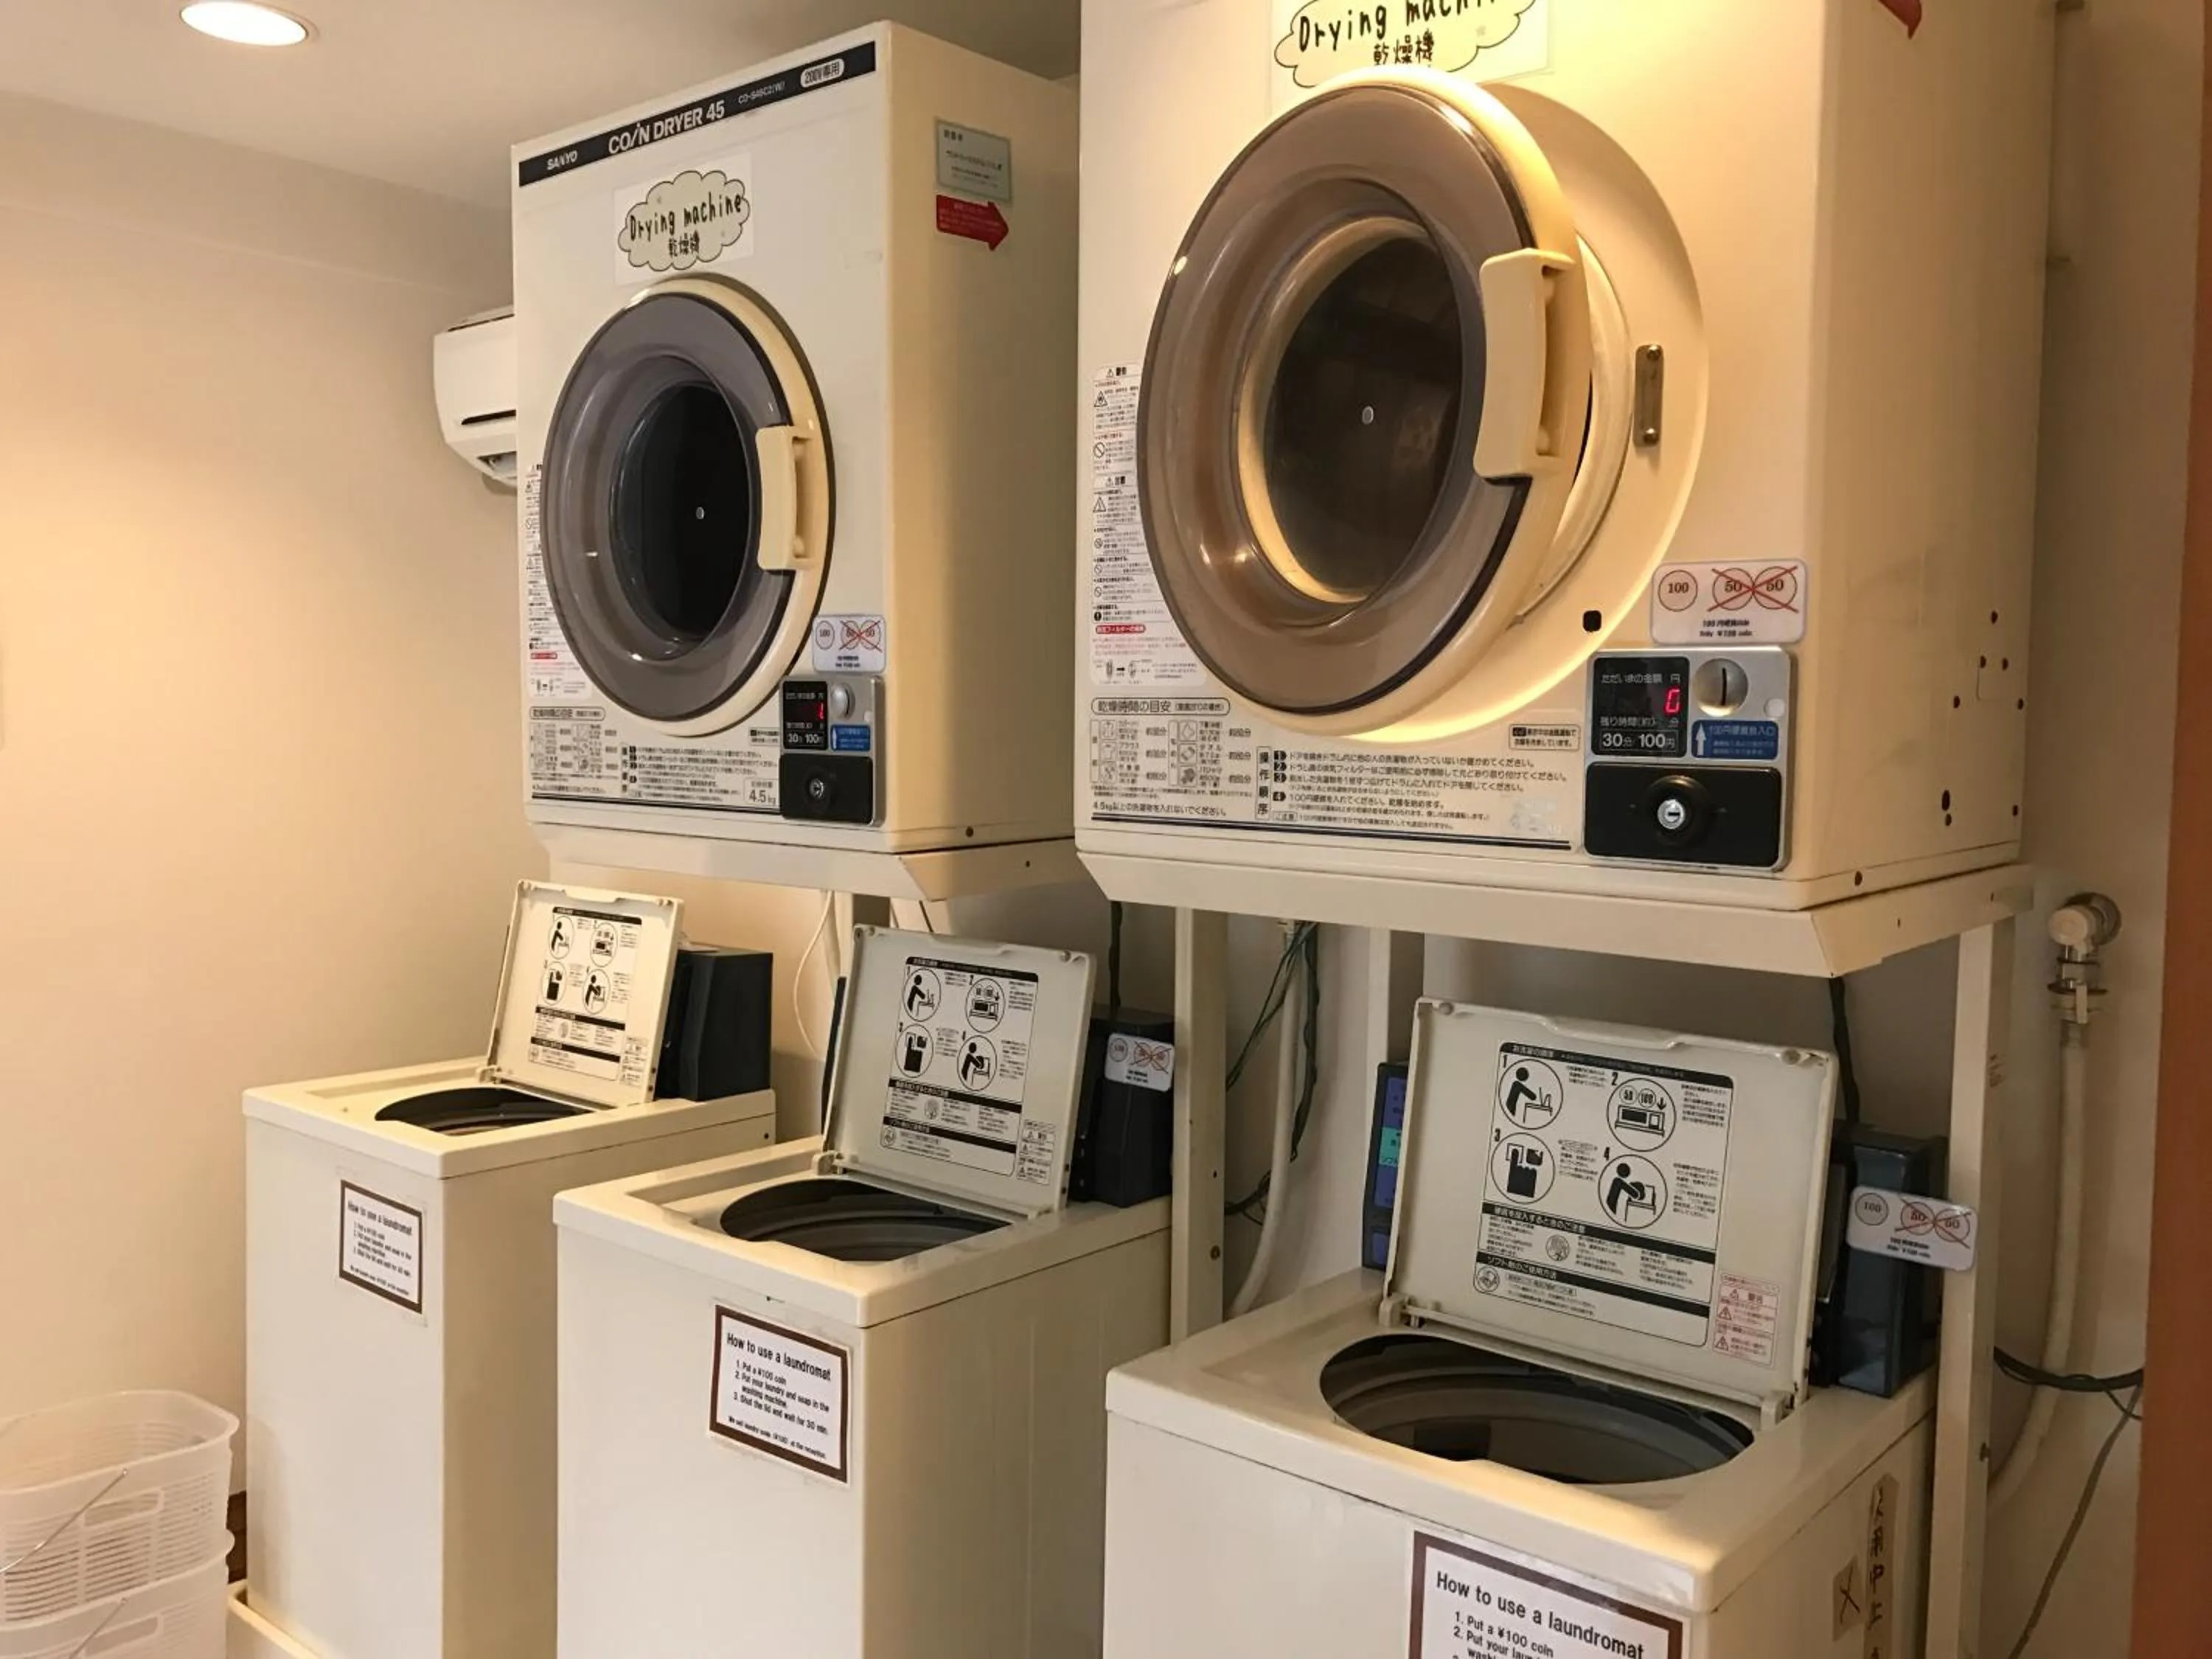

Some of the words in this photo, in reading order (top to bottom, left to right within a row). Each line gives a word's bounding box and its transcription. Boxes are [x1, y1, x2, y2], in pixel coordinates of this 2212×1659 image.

[1298, 4, 1387, 52] Drying
[1373, 28, 1434, 66] 乾燥機
[608, 122, 650, 155] COIN
[653, 106, 703, 141] DRYER
[706, 100, 726, 121] 45
[546, 148, 578, 170] SANYO
[630, 210, 675, 243] Drying
[684, 191, 742, 228] machine
[1668, 582, 1689, 594] 100
[1611, 1071, 1618, 1086] 2
[1495, 1128, 1500, 1142] 3
[726, 1332, 745, 1350] How
[746, 1339, 756, 1354] to
[757, 1346, 773, 1360] use
[775, 1352, 781, 1363] a
[783, 1352, 831, 1381] laundromat
[1436, 1571, 1470, 1599] How
[1475, 1585, 1492, 1606] to
[1497, 1596, 1526, 1619] use
[1532, 1609, 1543, 1626] a
[1548, 1610, 1644, 1659] laundromat
[1455, 1610, 1464, 1624] 1.
[1467, 1614, 1484, 1632] Put
[1487, 1624, 1494, 1635] a
[1498, 1626, 1528, 1648] ¥100
[1531, 1641, 1554, 1658] coin
[1453, 1625, 1464, 1639] 2.
[1467, 1630, 1484, 1646] Put
[1486, 1639, 1509, 1656] your
